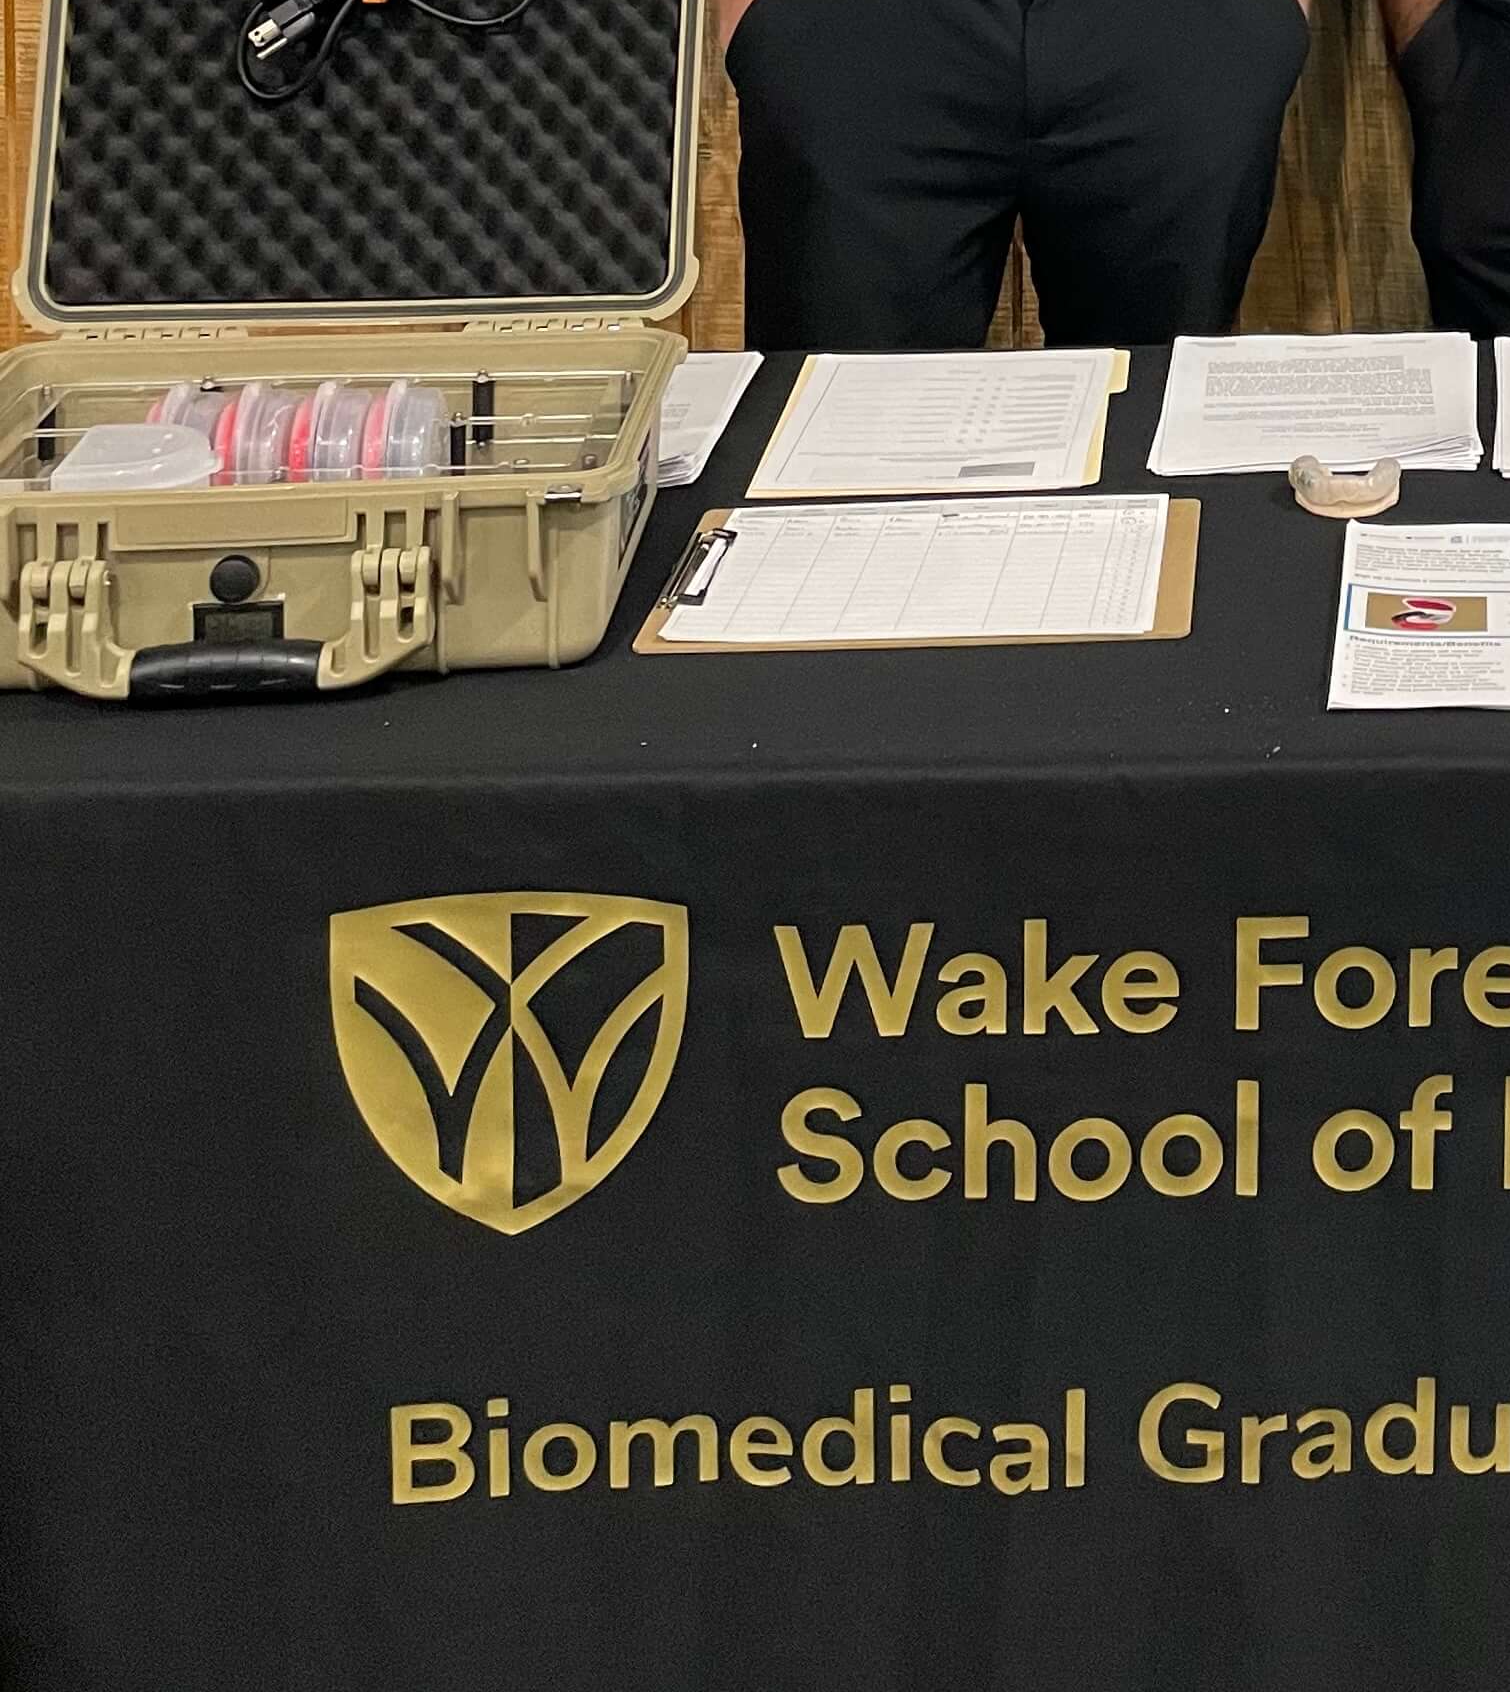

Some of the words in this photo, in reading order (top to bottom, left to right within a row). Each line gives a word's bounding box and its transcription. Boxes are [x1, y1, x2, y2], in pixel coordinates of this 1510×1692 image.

[775, 919, 1180, 1038] Wake
[777, 1079, 1259, 1203] School
[1312, 1075, 1453, 1192] of
[390, 1386, 1086, 1505] Biomedical
